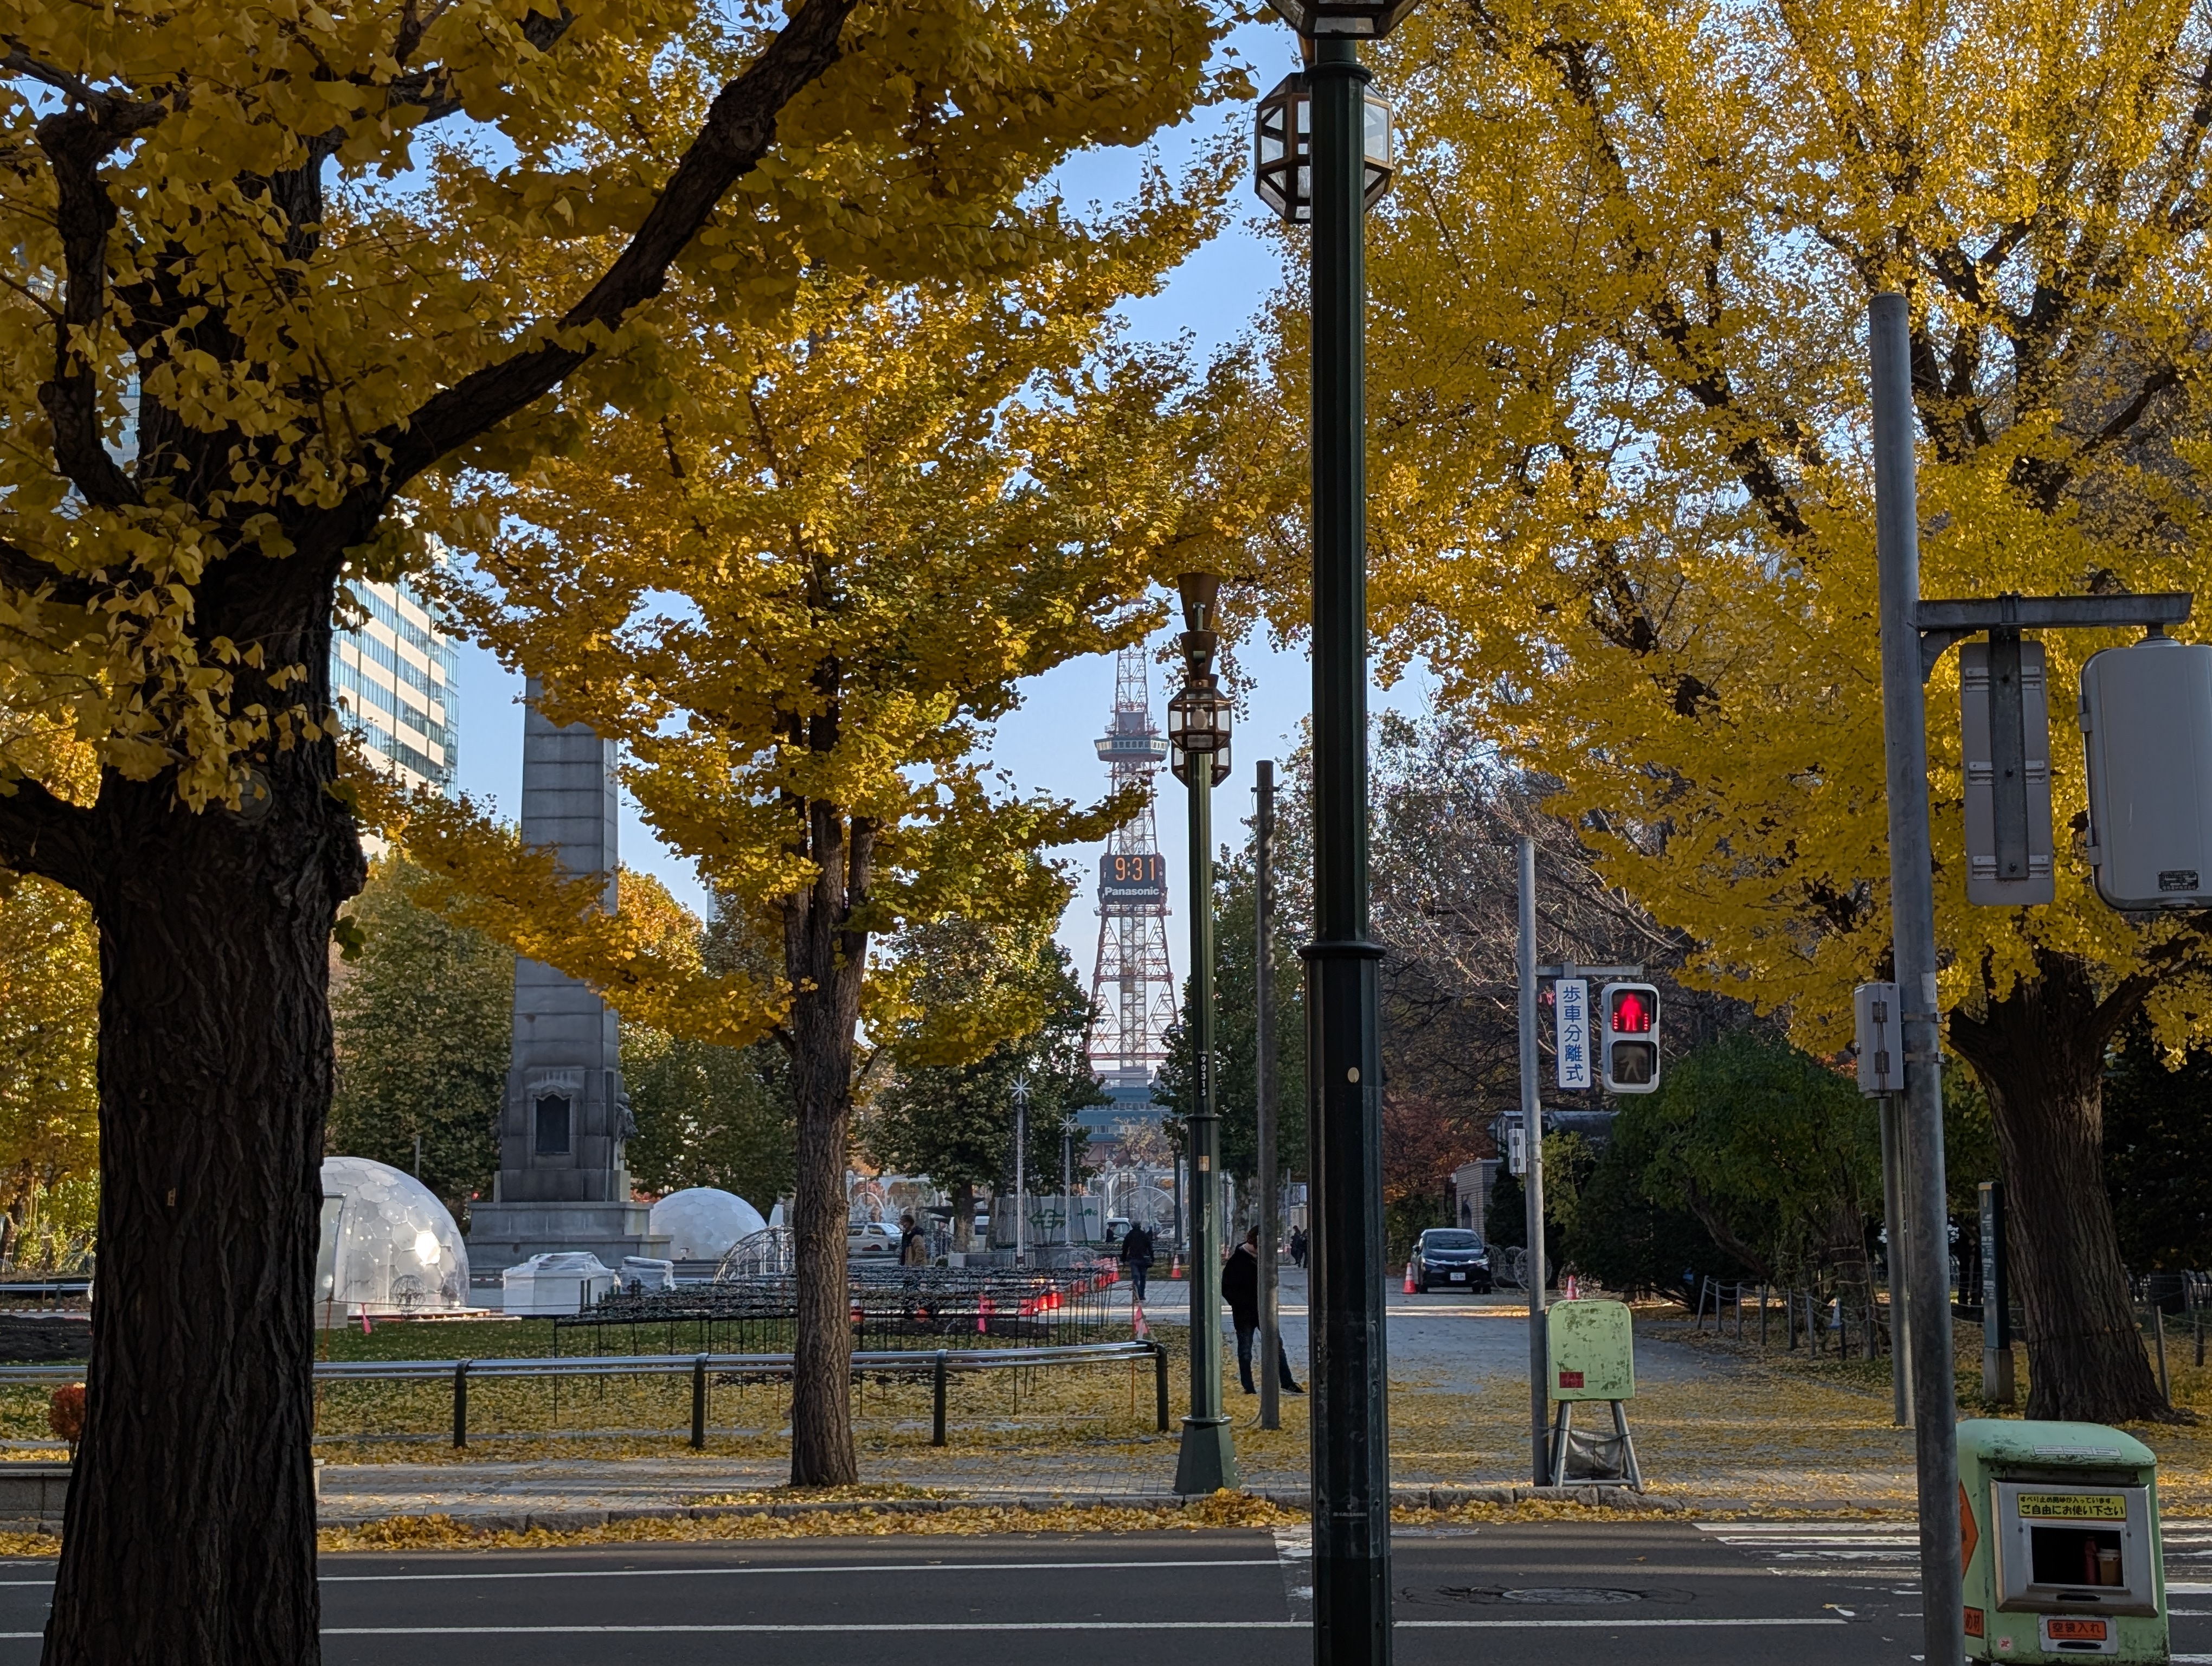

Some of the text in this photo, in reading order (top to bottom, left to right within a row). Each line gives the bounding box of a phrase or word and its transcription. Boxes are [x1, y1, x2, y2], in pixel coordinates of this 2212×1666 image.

[1115, 857, 1154, 881] 9:31
[1104, 886, 1160, 896] Panasonic
[1563, 985, 1584, 1082] 歩車分離式
[2021, 1504, 2124, 1516] ご自由にお使い下さい
[2052, 1622, 2101, 1633] 空袋入れ
